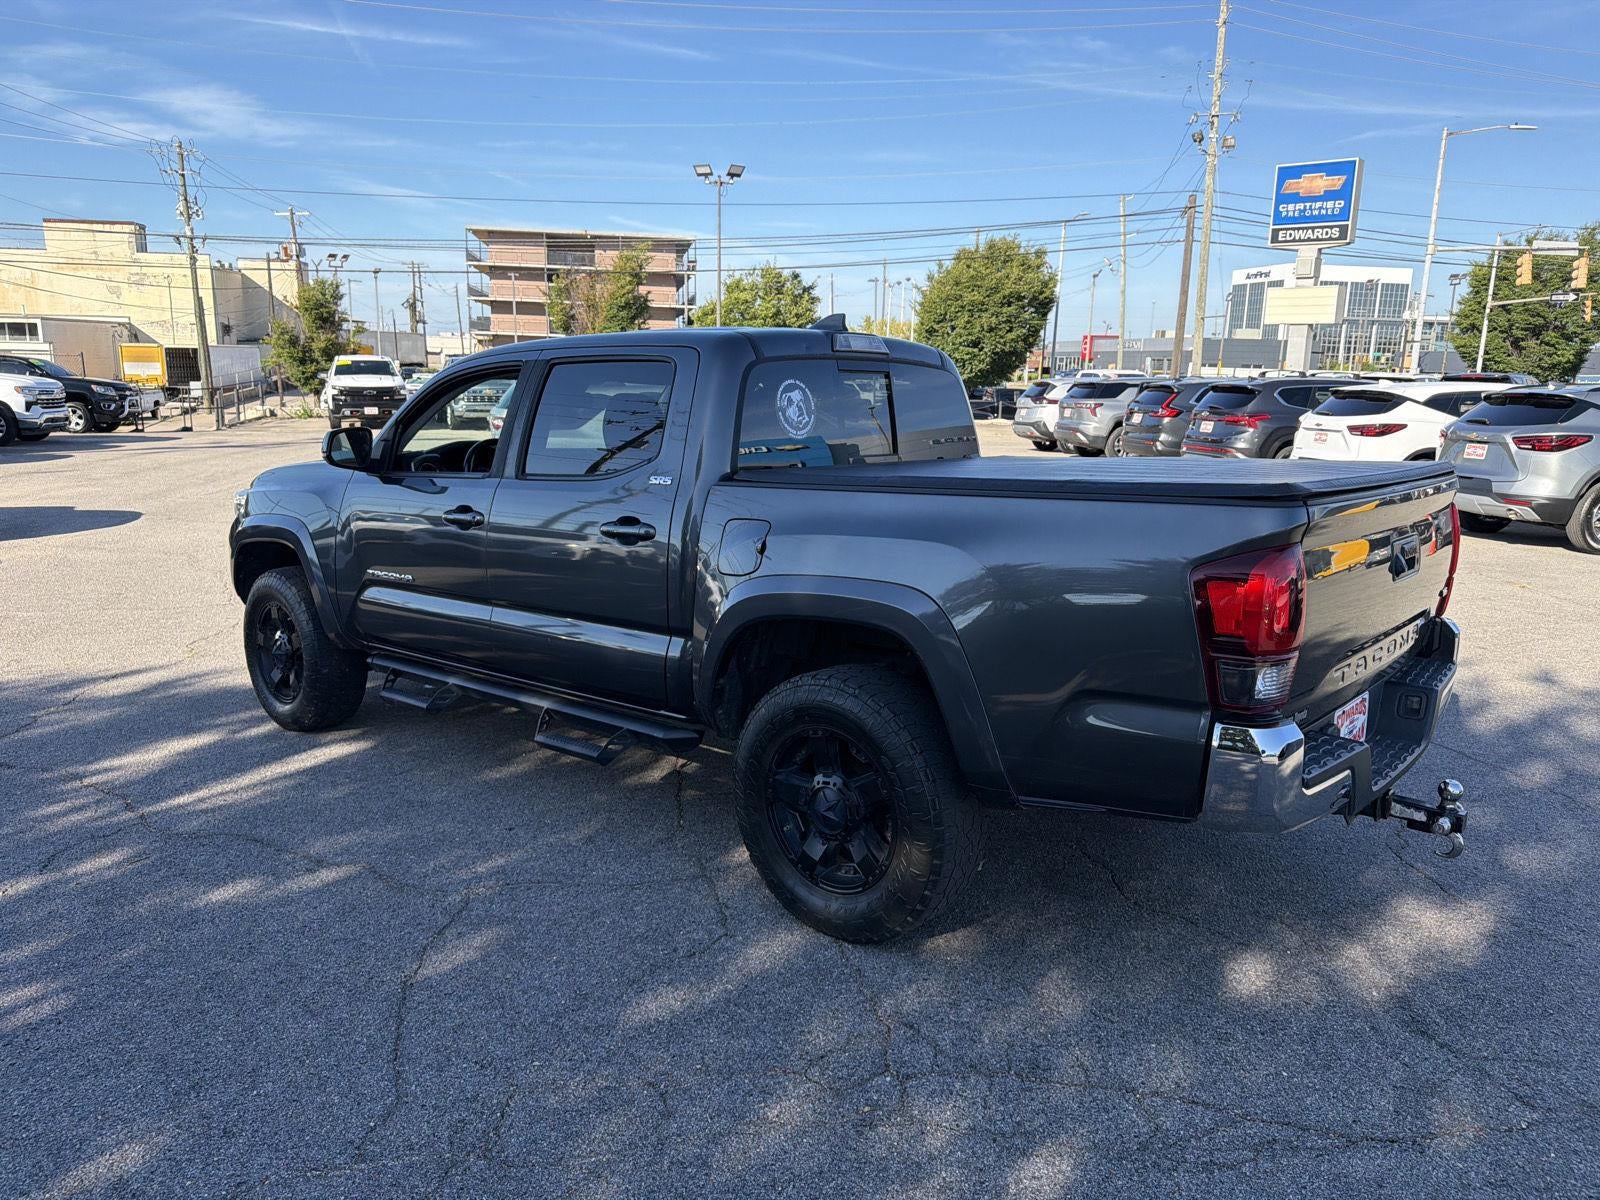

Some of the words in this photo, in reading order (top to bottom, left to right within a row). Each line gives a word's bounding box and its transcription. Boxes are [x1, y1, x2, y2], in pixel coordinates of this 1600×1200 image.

[1278, 200, 1345, 212] CERTIFIED
[1281, 207, 1340, 218] PRE-OWNED
[1278, 227, 1340, 241] EDWARDS
[1245, 269, 1271, 281] AmFirst
[649, 475, 673, 485] SR5
[366, 569, 415, 583] TACOMA
[1334, 623, 1420, 684] TACOMA
